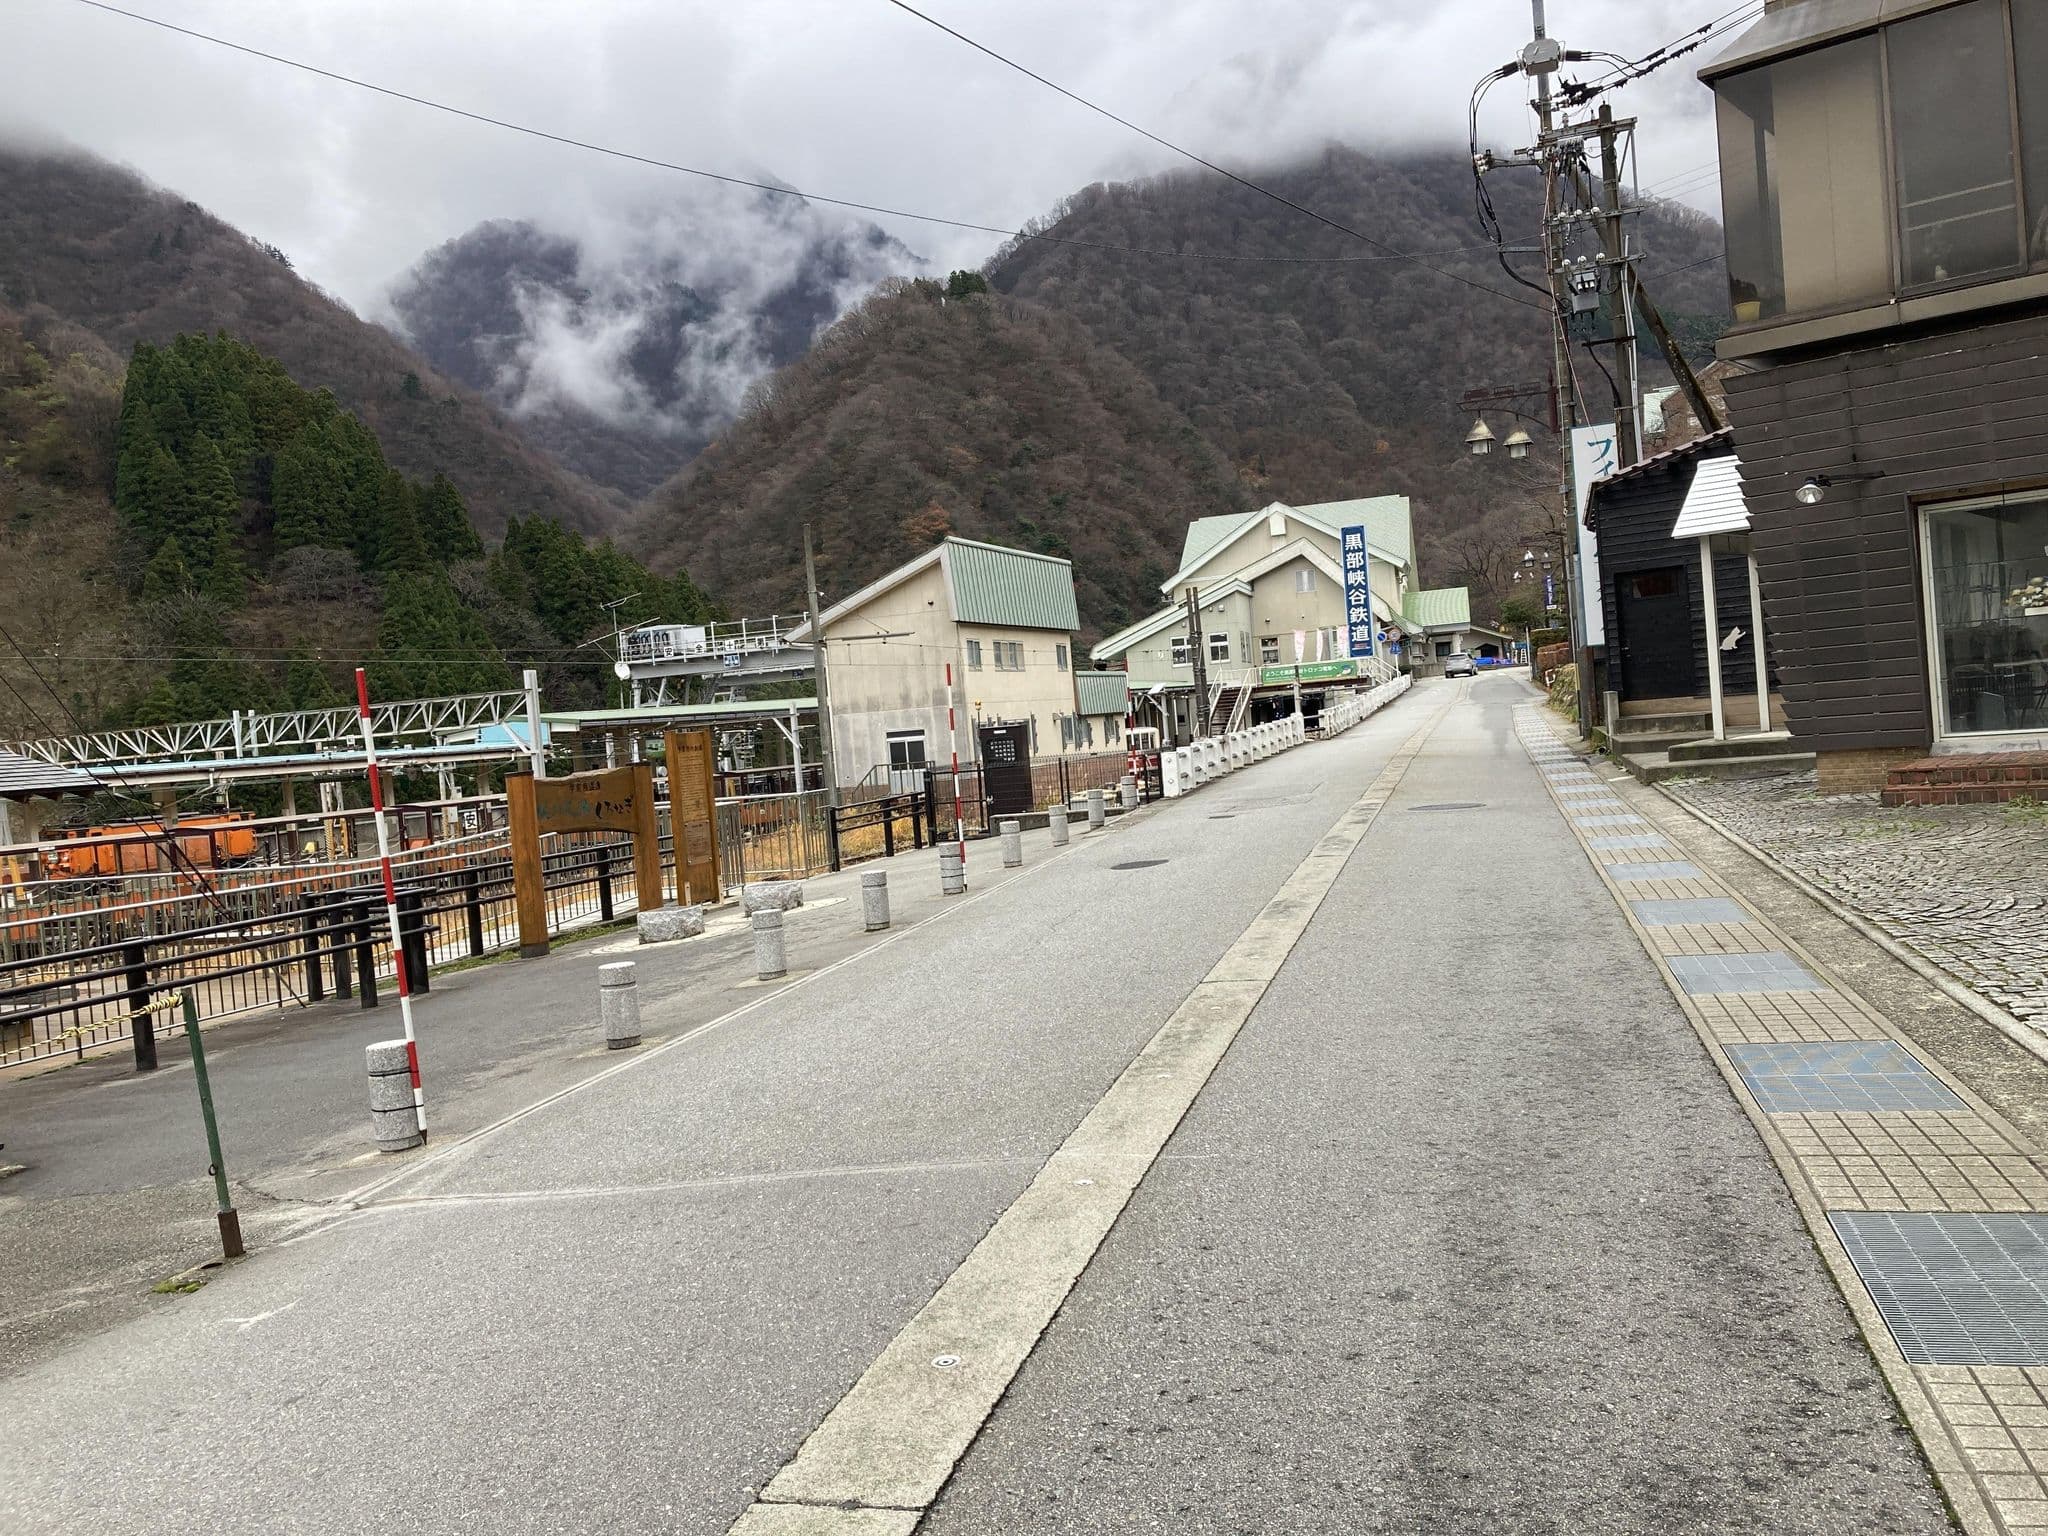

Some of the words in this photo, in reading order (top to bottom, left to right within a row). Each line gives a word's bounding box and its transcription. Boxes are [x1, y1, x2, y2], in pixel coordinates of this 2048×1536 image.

[1345, 533, 1369, 642] 黒部峡谷鉄道
